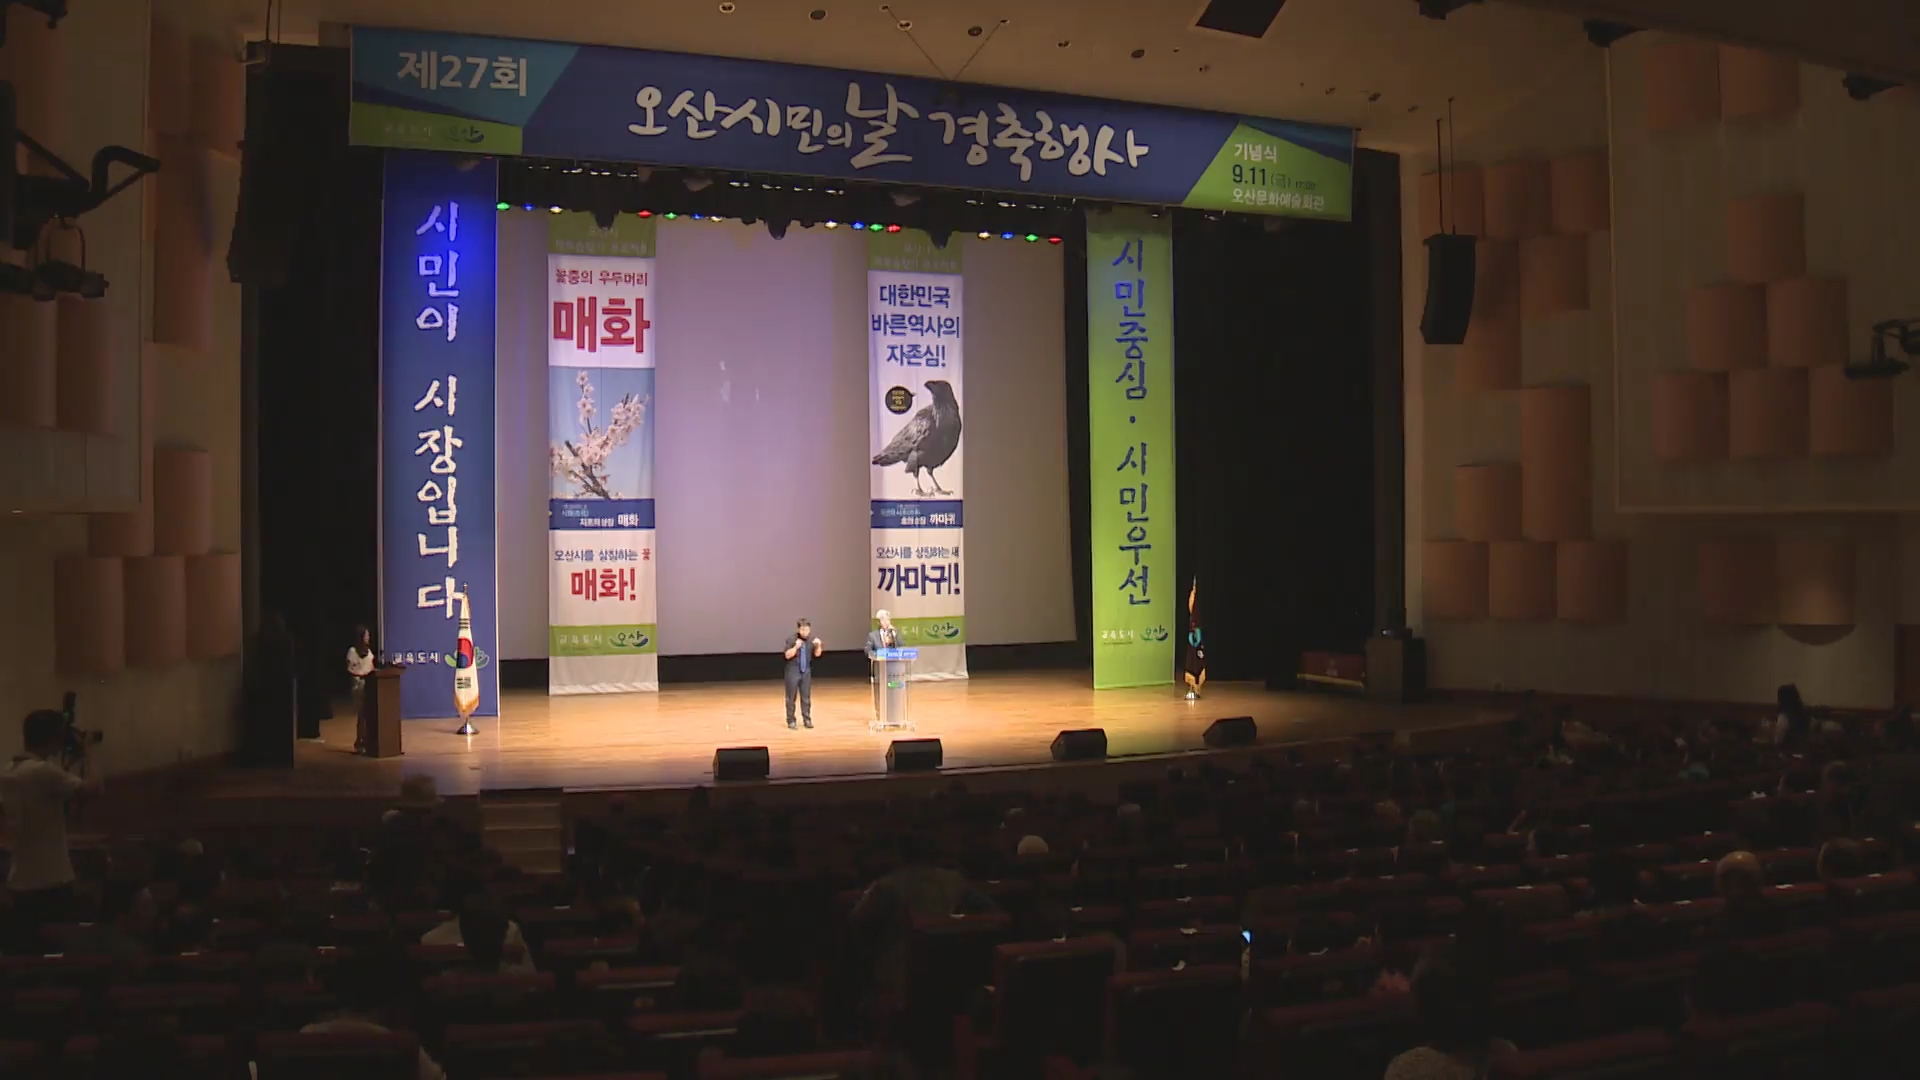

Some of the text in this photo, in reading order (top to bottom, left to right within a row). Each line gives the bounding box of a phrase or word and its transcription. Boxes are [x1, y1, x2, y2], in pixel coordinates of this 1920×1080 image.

[397, 50, 528, 97] 제27회
[928, 103, 1149, 182] 경축행사
[1234, 142, 1277, 163] 기념식
[1232, 164, 1266, 186] 9.11
[1231, 188, 1324, 211] 오산문화예술회관
[415, 200, 460, 342] 시민이
[599, 270, 648, 286] 우두머리
[879, 284, 951, 308] 대한민국
[553, 296, 650, 353] 매화
[871, 313, 960, 338] 바른역사의
[1112, 238, 1148, 400] 시민중심
[886, 344, 946, 368] 자존심!
[617, 513, 639, 527] 매화
[929, 512, 956, 525] 까마귀
[1116, 442, 1152, 605] 시민우선
[554, 550, 594, 562] 오산시를
[598, 549, 638, 562] 상징하는
[876, 546, 960, 559] 오산시를 상징하는 새
[571, 567, 636, 601] 매화!
[877, 563, 961, 597] 까마귀!
[609, 631, 649, 647] 오산
